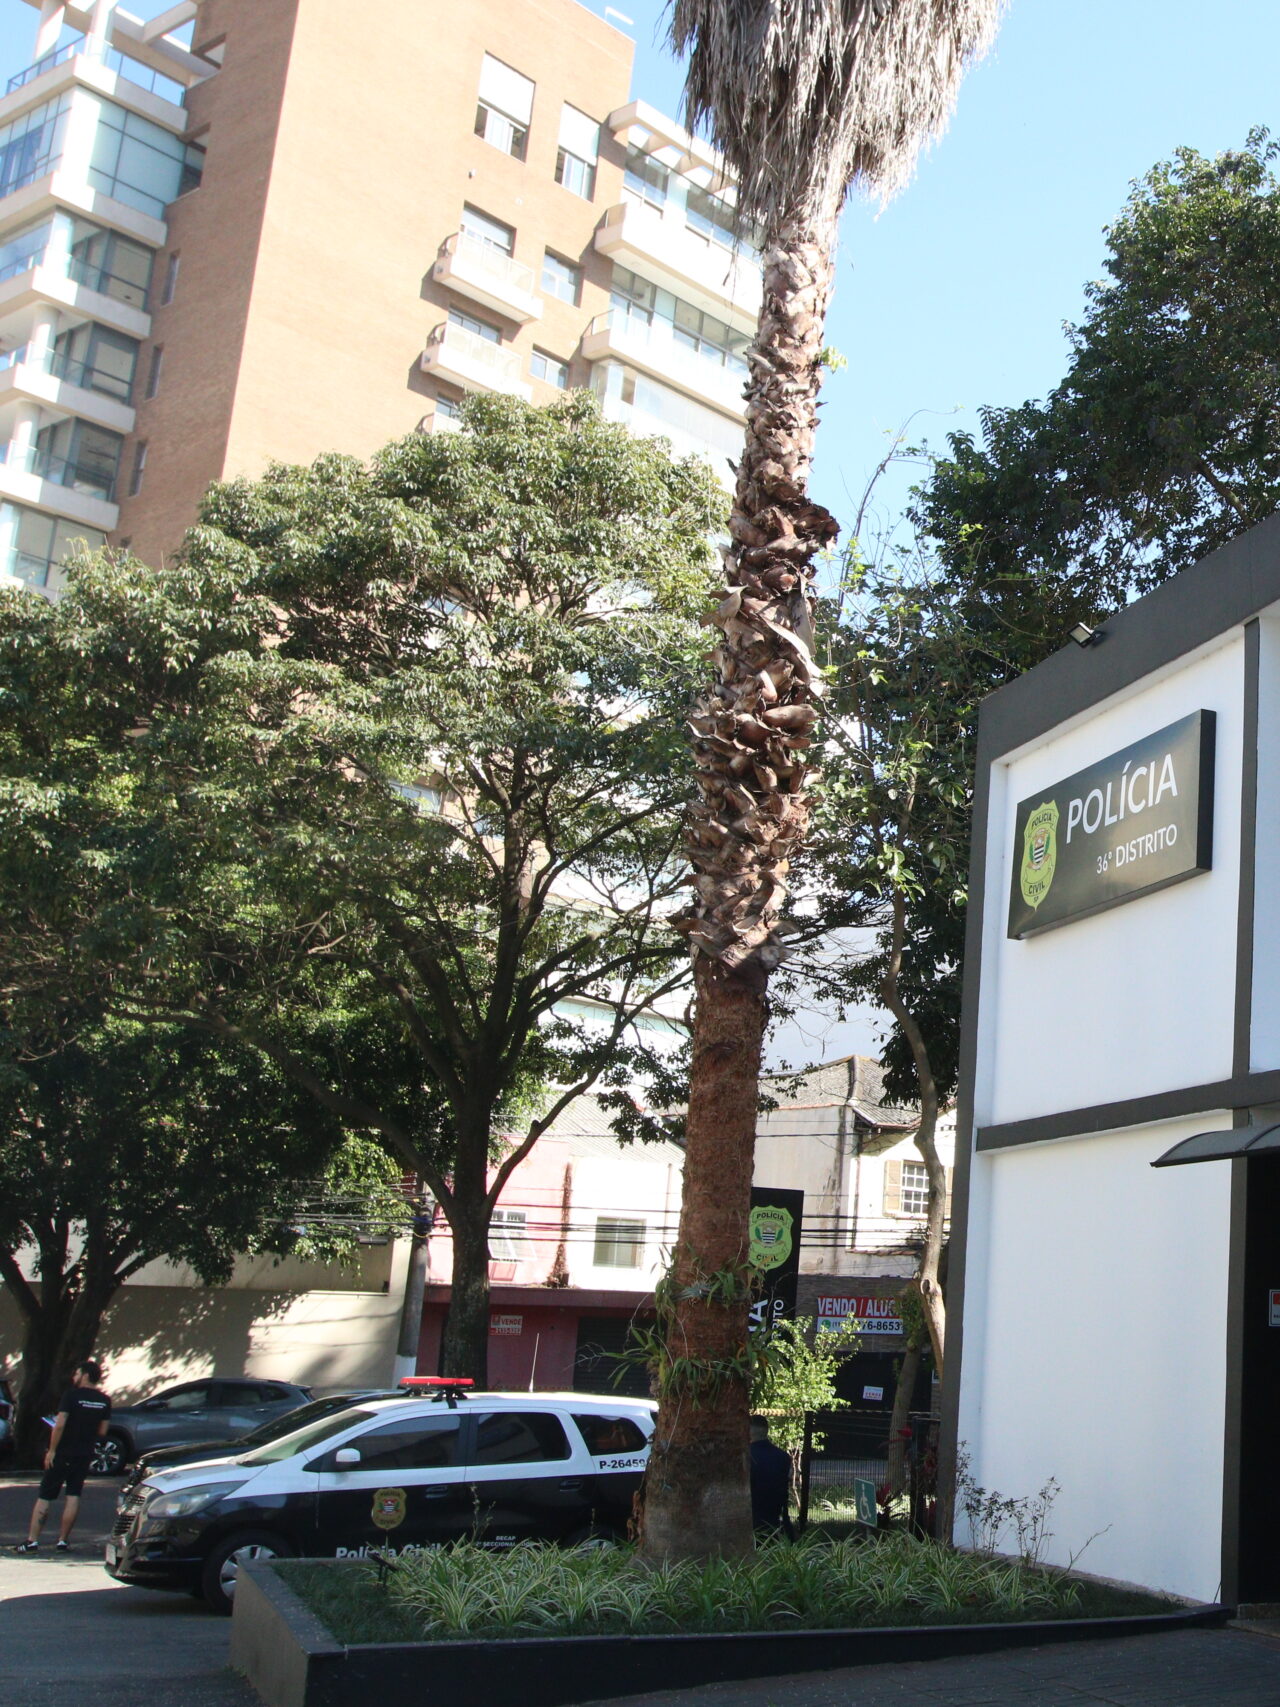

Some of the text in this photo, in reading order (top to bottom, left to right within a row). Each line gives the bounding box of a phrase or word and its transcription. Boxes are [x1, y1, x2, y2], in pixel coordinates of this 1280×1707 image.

[1066, 754, 1178, 844] POLÍCIA
[1116, 824, 1178, 868] DISTRITO
[1028, 881, 1046, 895] CIVIL
[817, 1297, 857, 1316] VENDO
[865, 1299, 898, 1316] ALU
